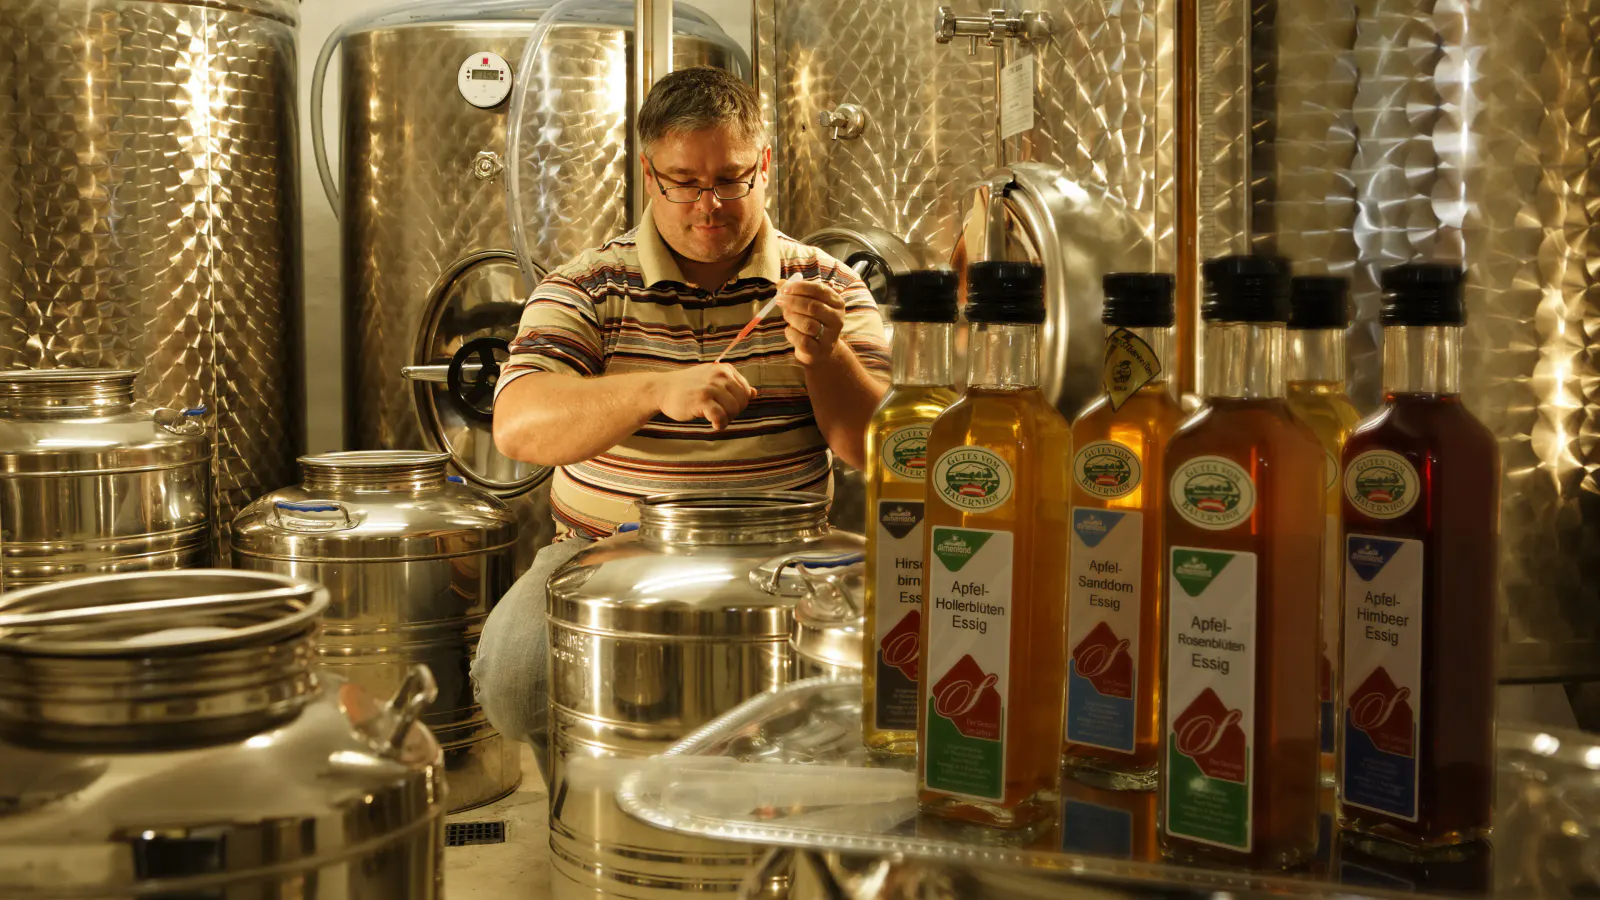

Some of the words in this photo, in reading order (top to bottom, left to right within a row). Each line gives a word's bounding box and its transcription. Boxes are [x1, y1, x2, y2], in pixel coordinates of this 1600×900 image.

[894, 430, 923, 443] GUTES
[945, 452, 978, 466] GUTES
[981, 455, 1001, 469] VOM
[1084, 447, 1112, 459] GUTES
[1114, 449, 1132, 461] VOM
[1184, 464, 1217, 478] GUTES
[1221, 466, 1241, 483] VOM
[1356, 458, 1385, 472] GUTES
[1388, 461, 1406, 476] VOM
[1082, 477, 1130, 494] BAUERNHOF
[943, 485, 1000, 507] BAUERNHOF
[1353, 493, 1405, 513] BAUERNHOF
[1182, 500, 1240, 521] BAUERNHOF
[937, 543, 972, 555] Almenland
[1089, 560, 1122, 575] Apfel-
[951, 581, 990, 597] Apfel-
[1078, 575, 1134, 593] Sanddorn
[935, 597, 1005, 616] Hollerblüten
[1089, 594, 1121, 612] Essig
[1364, 590, 1401, 607] Apfel-
[952, 615, 987, 634] Essig
[1191, 616, 1232, 633] Apfel-
[1357, 607, 1410, 627] Himbeer
[1177, 633, 1246, 652] Rosenblüten
[1365, 625, 1399, 646] Essig
[1191, 653, 1230, 675] Essig
